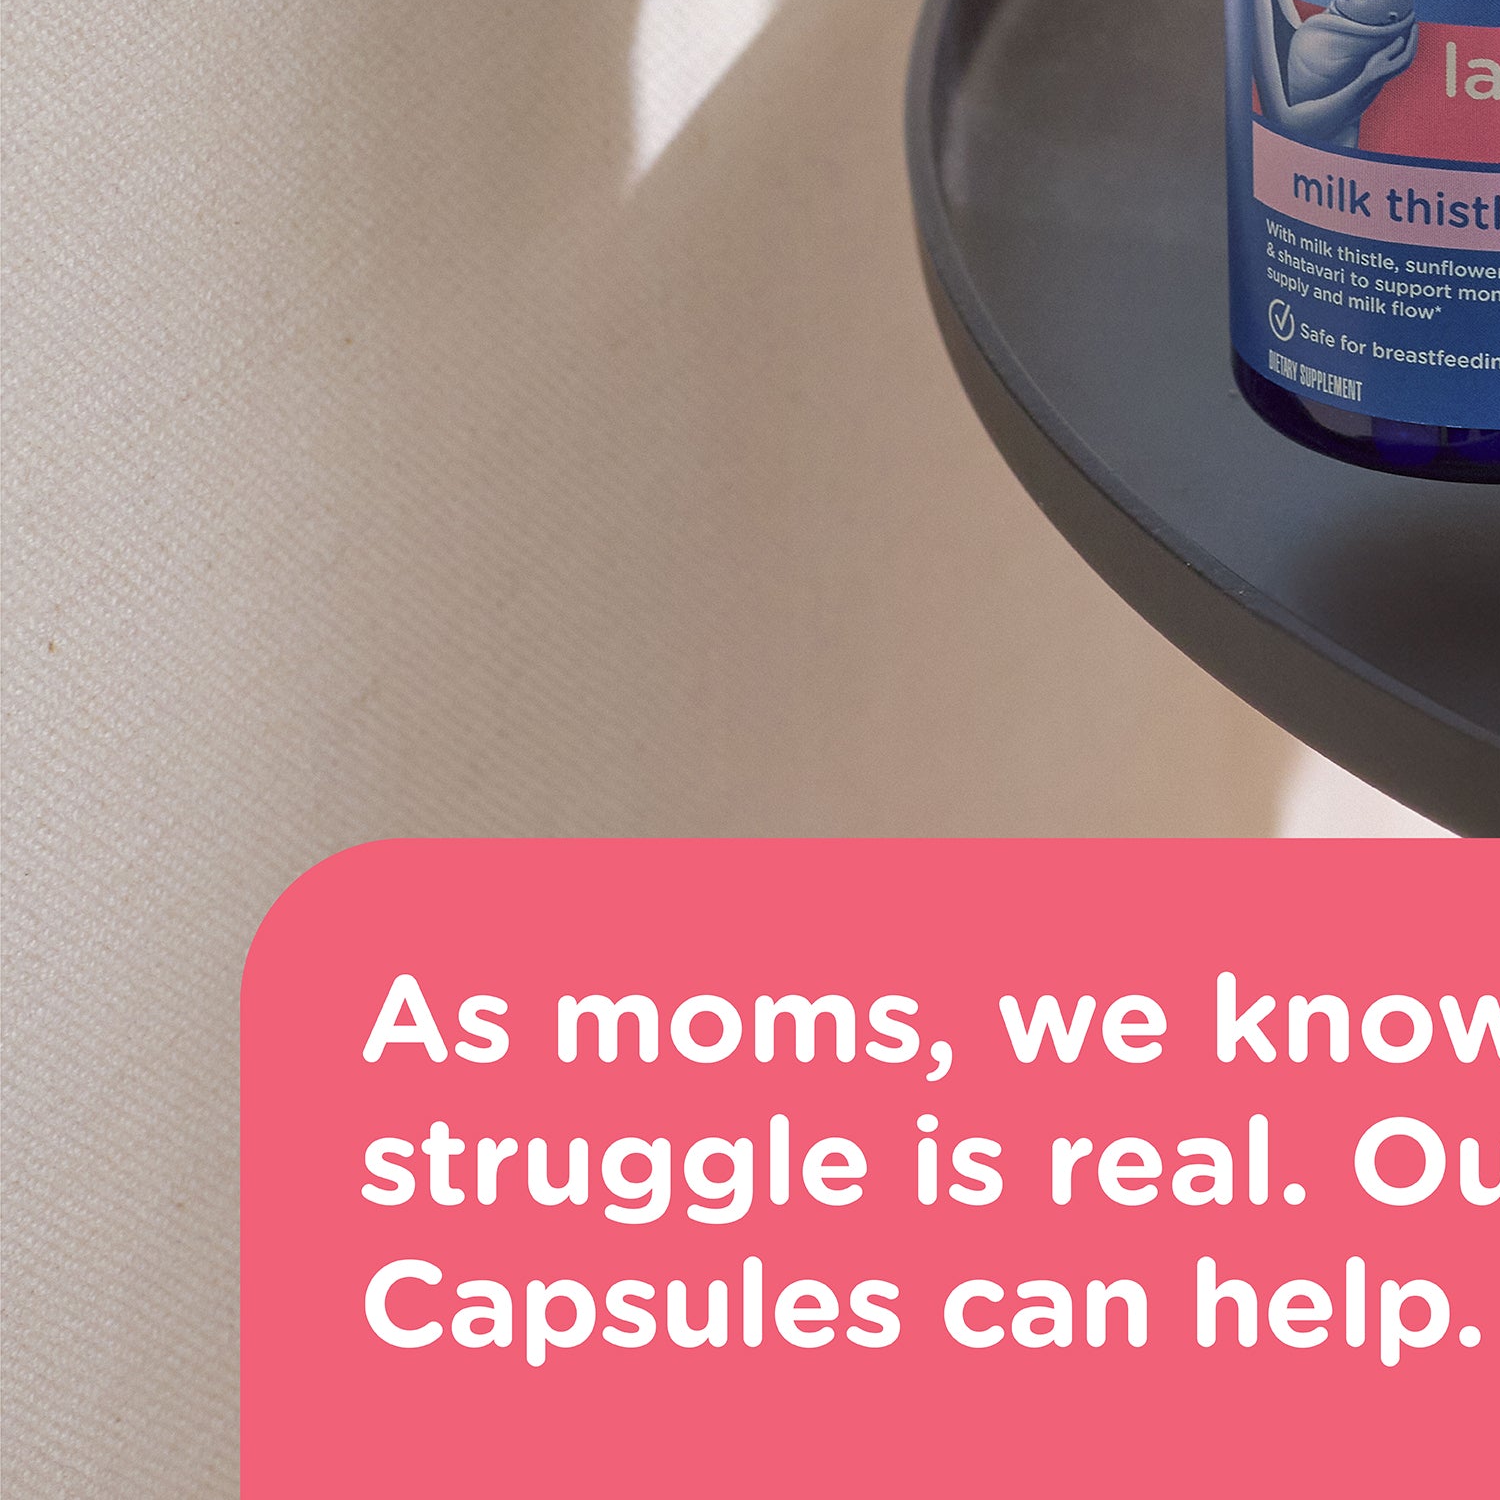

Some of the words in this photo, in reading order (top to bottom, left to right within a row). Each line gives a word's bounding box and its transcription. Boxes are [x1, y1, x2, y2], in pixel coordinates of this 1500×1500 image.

[1293, 171, 1371, 218] milk
[1266, 218, 1297, 246] With
[1300, 236, 1333, 258] milk
[1337, 246, 1399, 274] thistle,
[1266, 242, 1276, 259] &
[1278, 250, 1345, 284] shatavari
[1350, 271, 1369, 289] to
[1375, 278, 1452, 299] support
[1266, 266, 1310, 298] supply
[1313, 286, 1343, 306] and
[1348, 296, 1386, 315] milk
[1300, 322, 1336, 348] Safe
[1340, 335, 1367, 355] for
[1268, 349, 1298, 383] DIETARY
[1299, 363, 1363, 403] SUPPLEMENT
